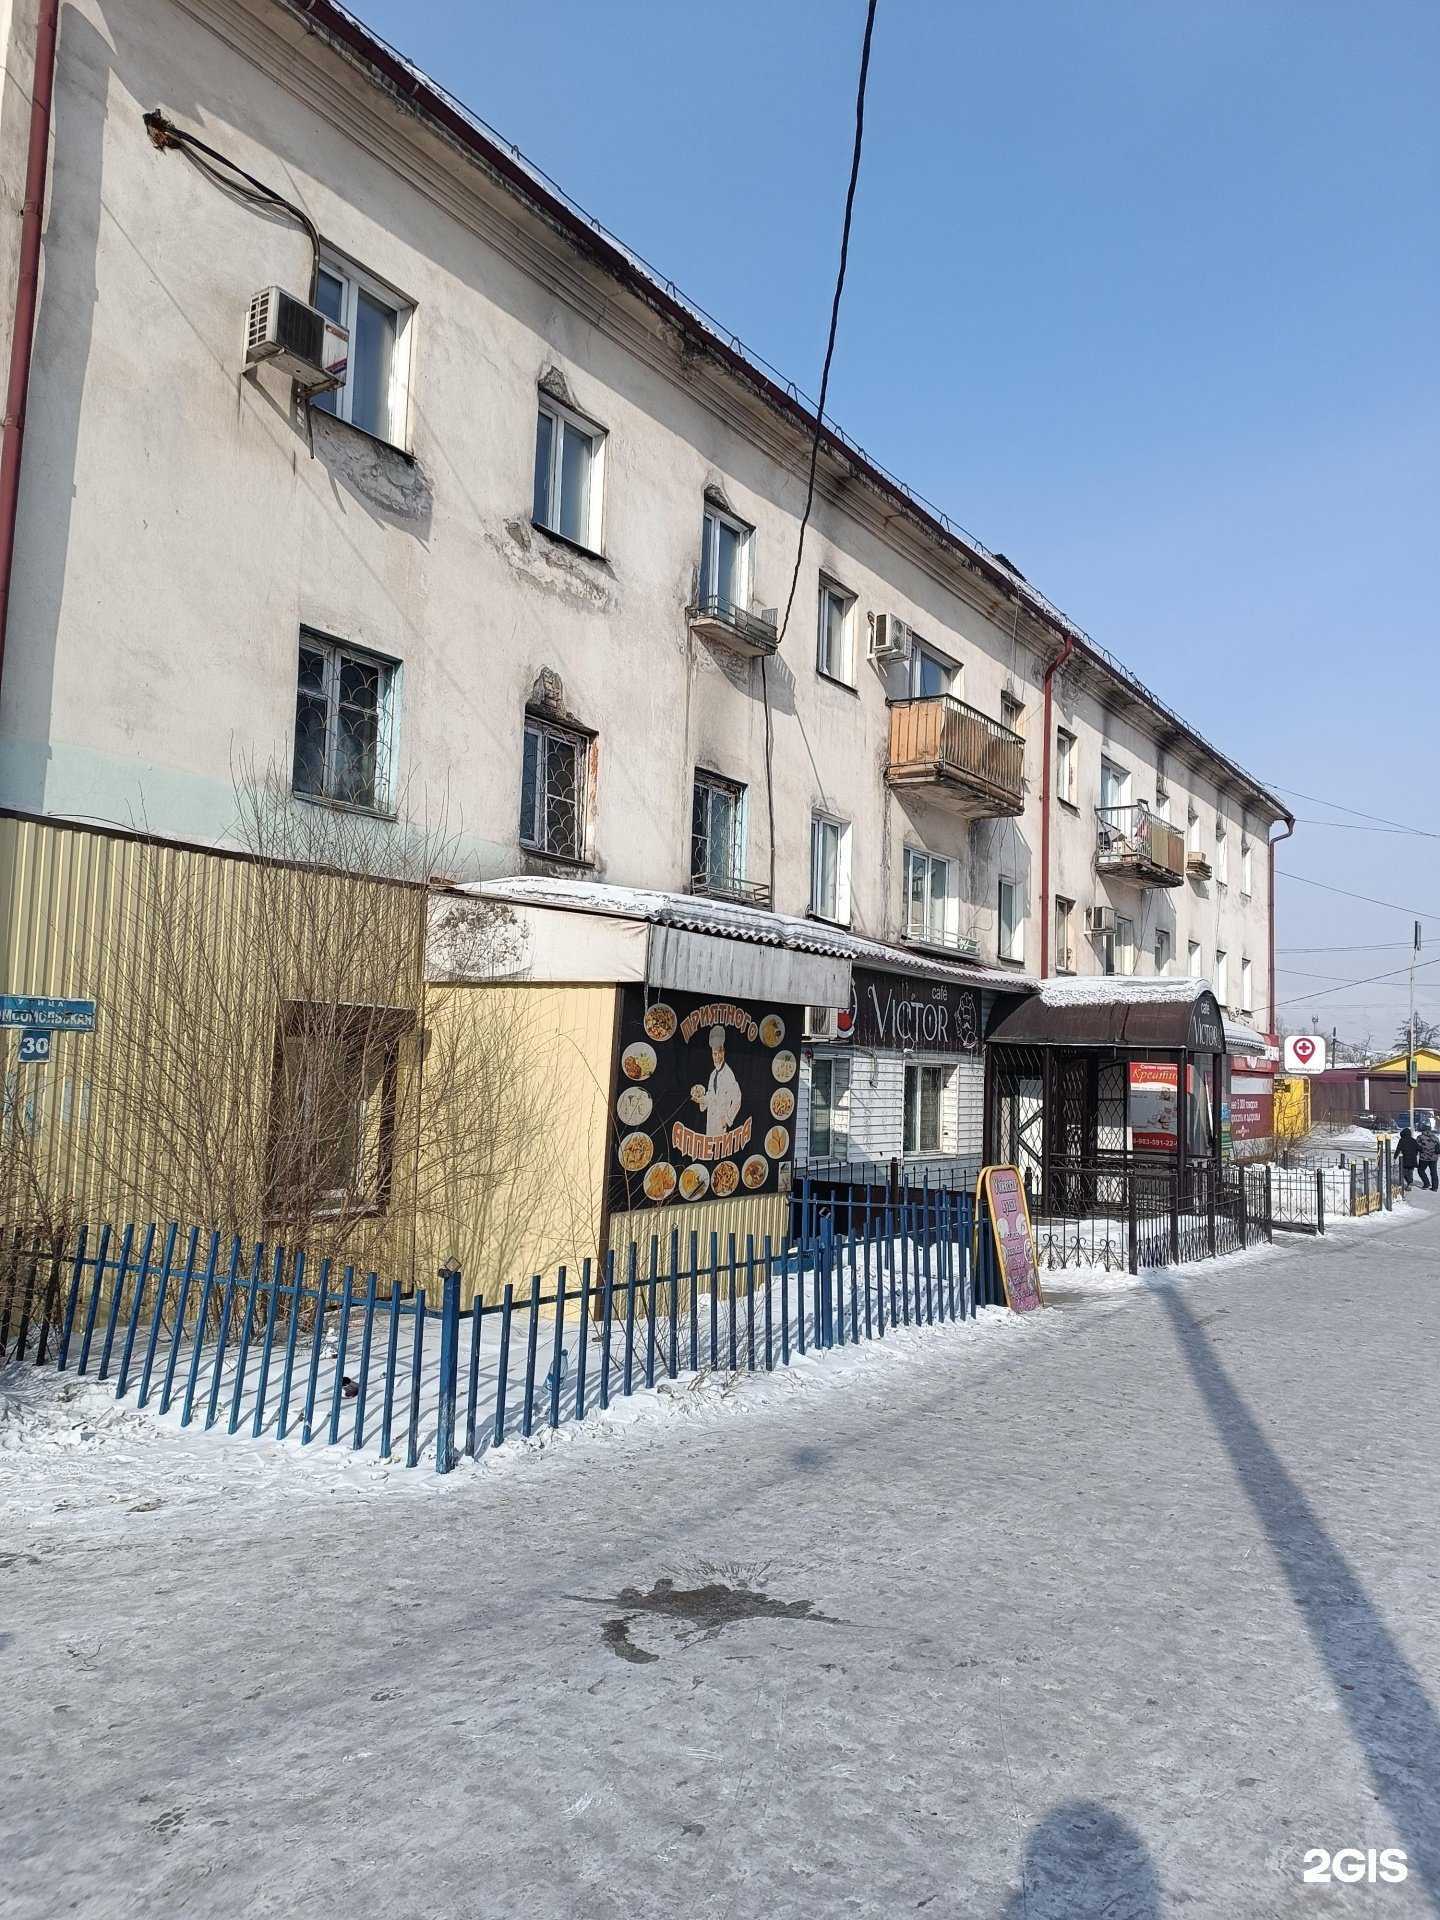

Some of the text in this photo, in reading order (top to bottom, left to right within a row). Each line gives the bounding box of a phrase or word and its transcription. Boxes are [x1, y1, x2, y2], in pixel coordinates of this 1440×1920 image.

[931, 986, 948, 1000] café
[680, 1002, 758, 1044] ПРИЯТНОГО
[22, 1037, 49, 1054] 30
[672, 1116, 752, 1161] АППЕТИТА
